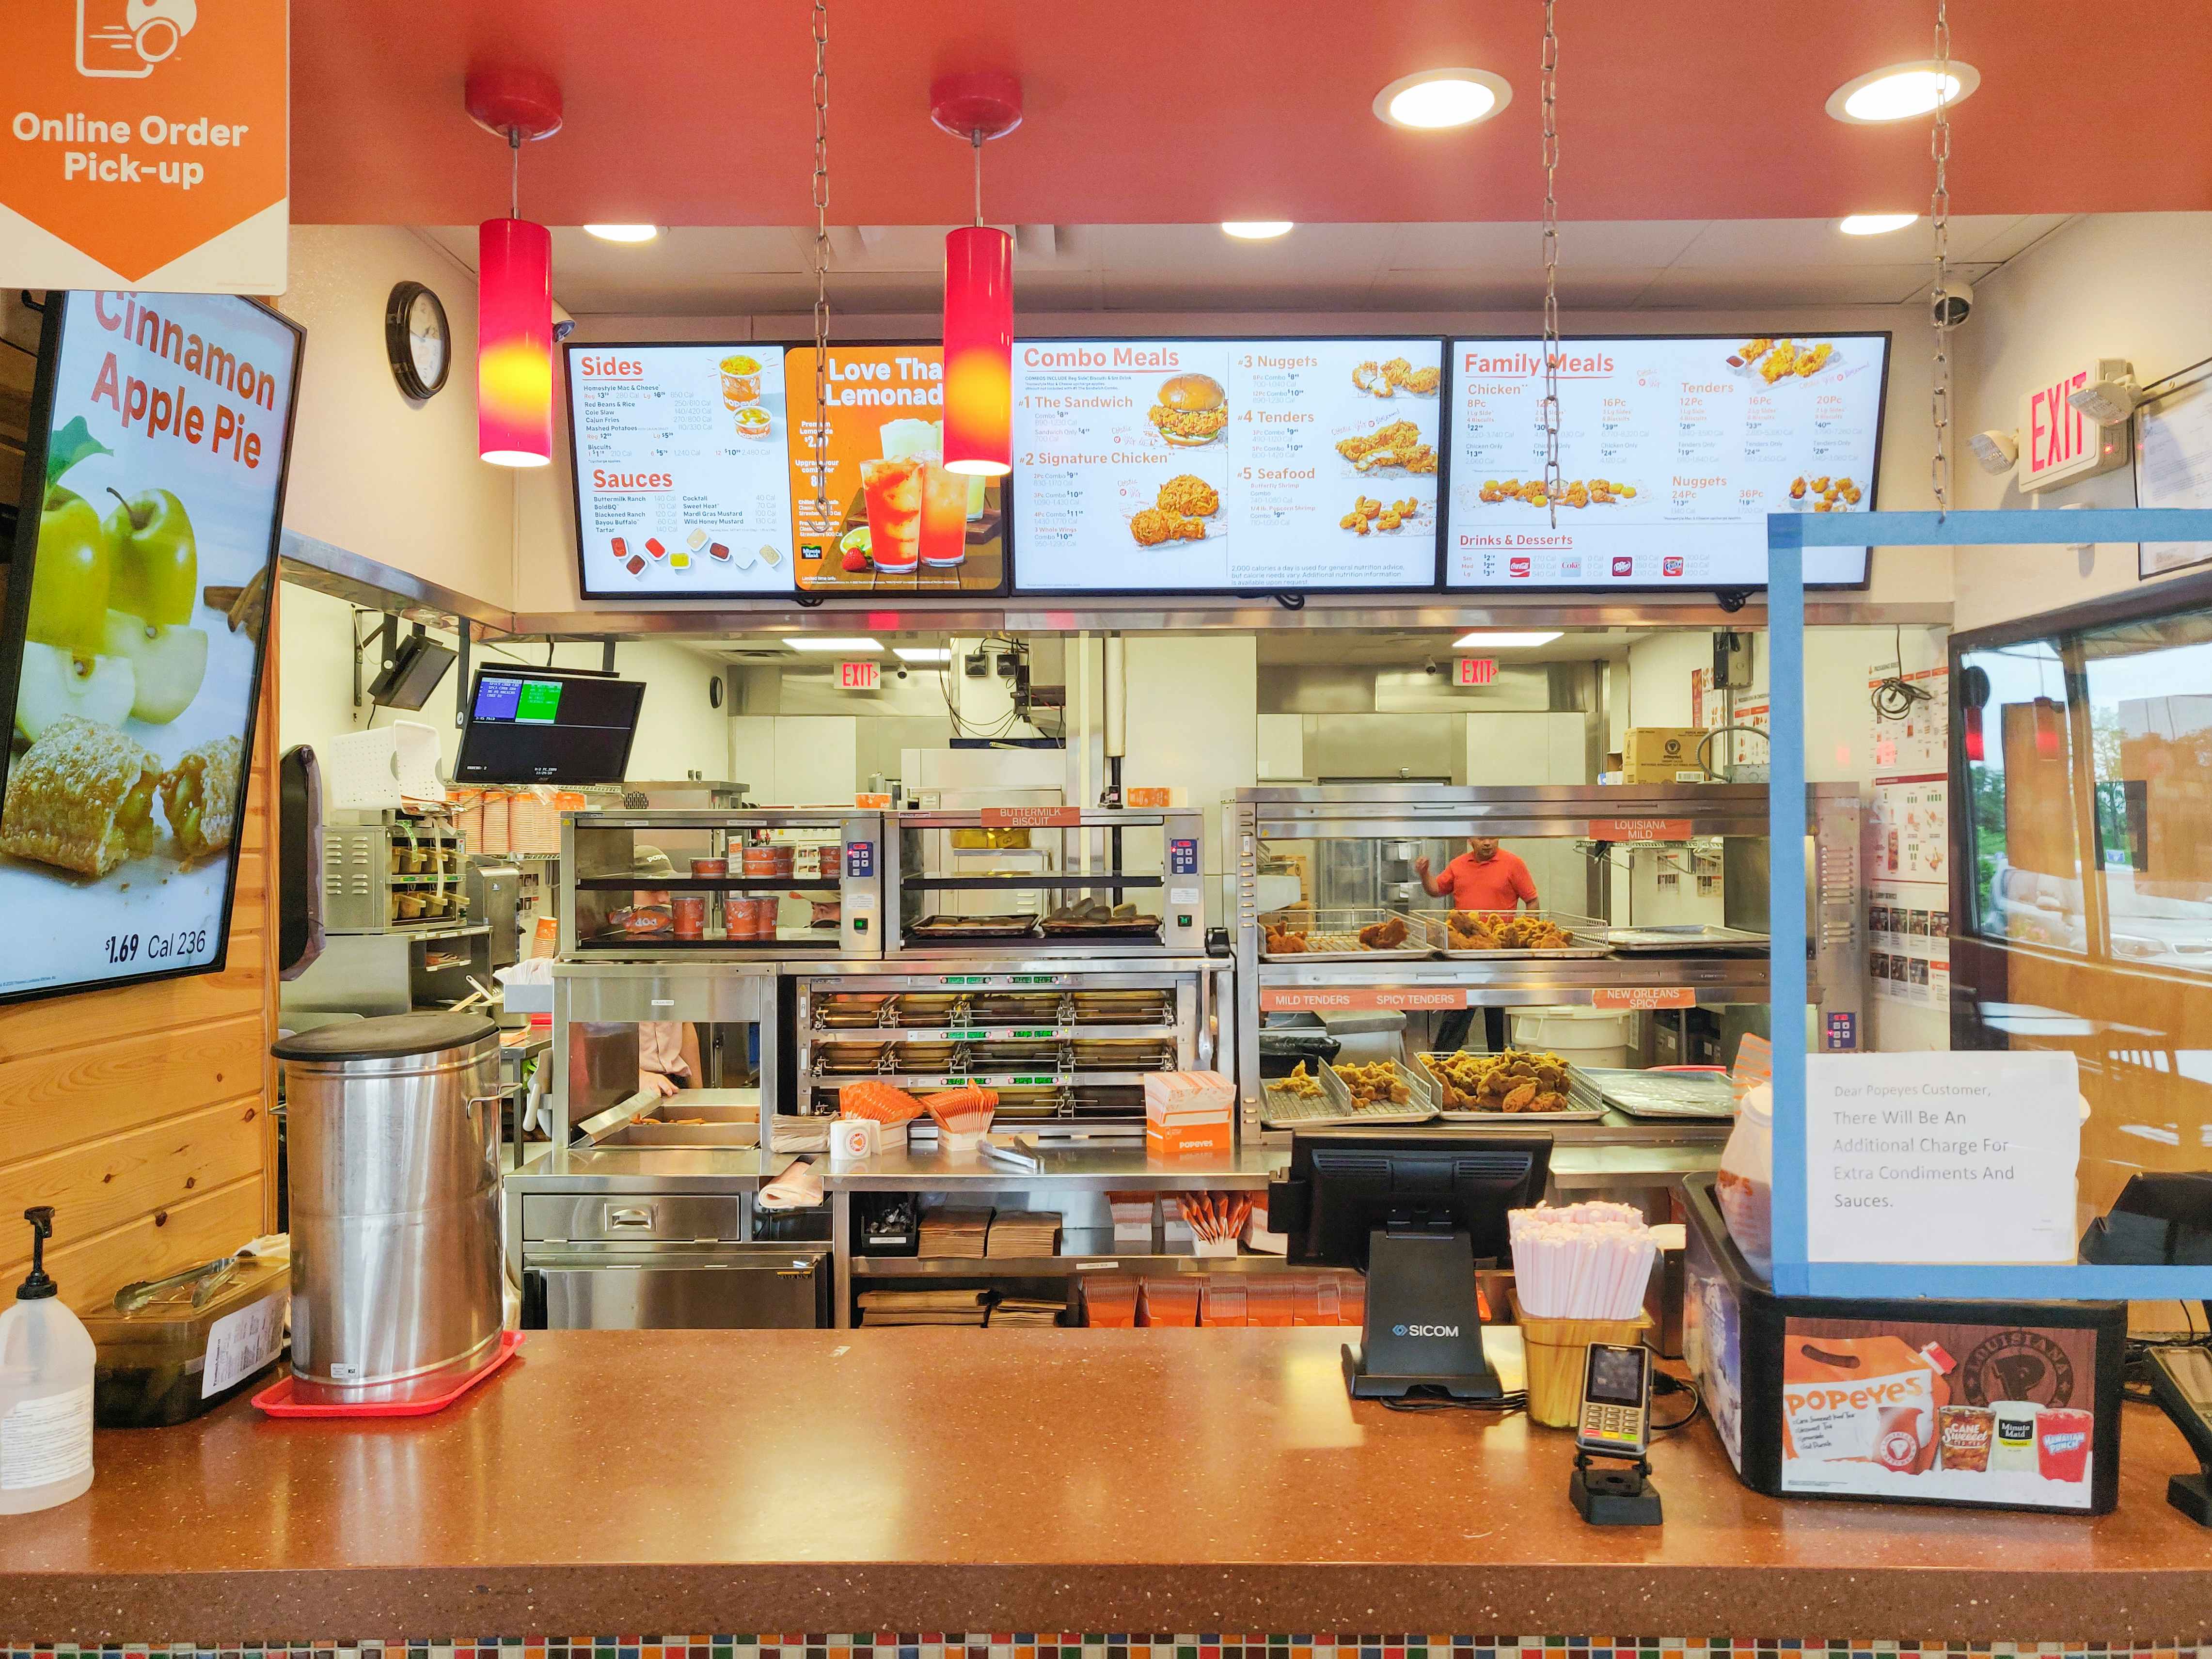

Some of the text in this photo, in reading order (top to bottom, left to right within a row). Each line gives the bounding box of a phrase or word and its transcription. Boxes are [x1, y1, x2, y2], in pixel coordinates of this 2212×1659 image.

[12, 111, 248, 146] Online Order
[64, 151, 204, 190] Pick-up
[95, 291, 275, 411] Cinnamon
[1024, 347, 1179, 367] Combo Meals
[582, 356, 643, 376] Sides
[829, 358, 943, 380] Love Tha
[1258, 356, 1317, 369] Nuggets
[1466, 353, 1614, 376] Family Meals
[1682, 382, 1733, 393] Tenders
[825, 383, 943, 406] Lemonad
[1035, 396, 1060, 408] The
[1065, 395, 1133, 408] Sandwich
[91, 351, 261, 469] Apple Pie
[1258, 411, 1314, 423] Tenders
[2031, 372, 2087, 473] EXIT
[1039, 453, 1107, 466] Signature
[593, 469, 673, 488] Sauces
[1258, 468, 1315, 479] Seafood
[1673, 476, 1727, 488] Nuggets
[1460, 535, 1573, 546] Drinks & Desserts
[843, 663, 872, 686] EXIT
[1462, 660, 1491, 683] EXIT
[1000, 808, 1061, 817] BUTTERMILK
[1012, 817, 1049, 826] BISCUIT
[1614, 820, 1666, 830] LOUISIANA
[1628, 830, 1652, 839] MILD
[105, 930, 206, 964] $1.69 Cal 236
[1276, 994, 1350, 1006] MILD TENDERS
[1376, 993, 1454, 1005] SPICY TENDERS
[1607, 989, 1679, 999] NEW ORLEANS
[1629, 998, 1658, 1008] SPICY
[1834, 1084, 1991, 1097] Dear Popeyes Customer,
[1833, 1111, 1966, 1124] There Will Be An
[1833, 1138, 2008, 1155] Additional Charge For
[1834, 1166, 2014, 1180] Extra Condiments And
[1834, 1194, 1893, 1207] Sauces.
[1409, 1324, 1458, 1337] SICOM
[1951, 1423, 1980, 1433] CANE
[2002, 1423, 2030, 1431] Minute
[2044, 1433, 2085, 1444] HAWAIIAN
[2050, 1442, 2079, 1455] PUNCH
